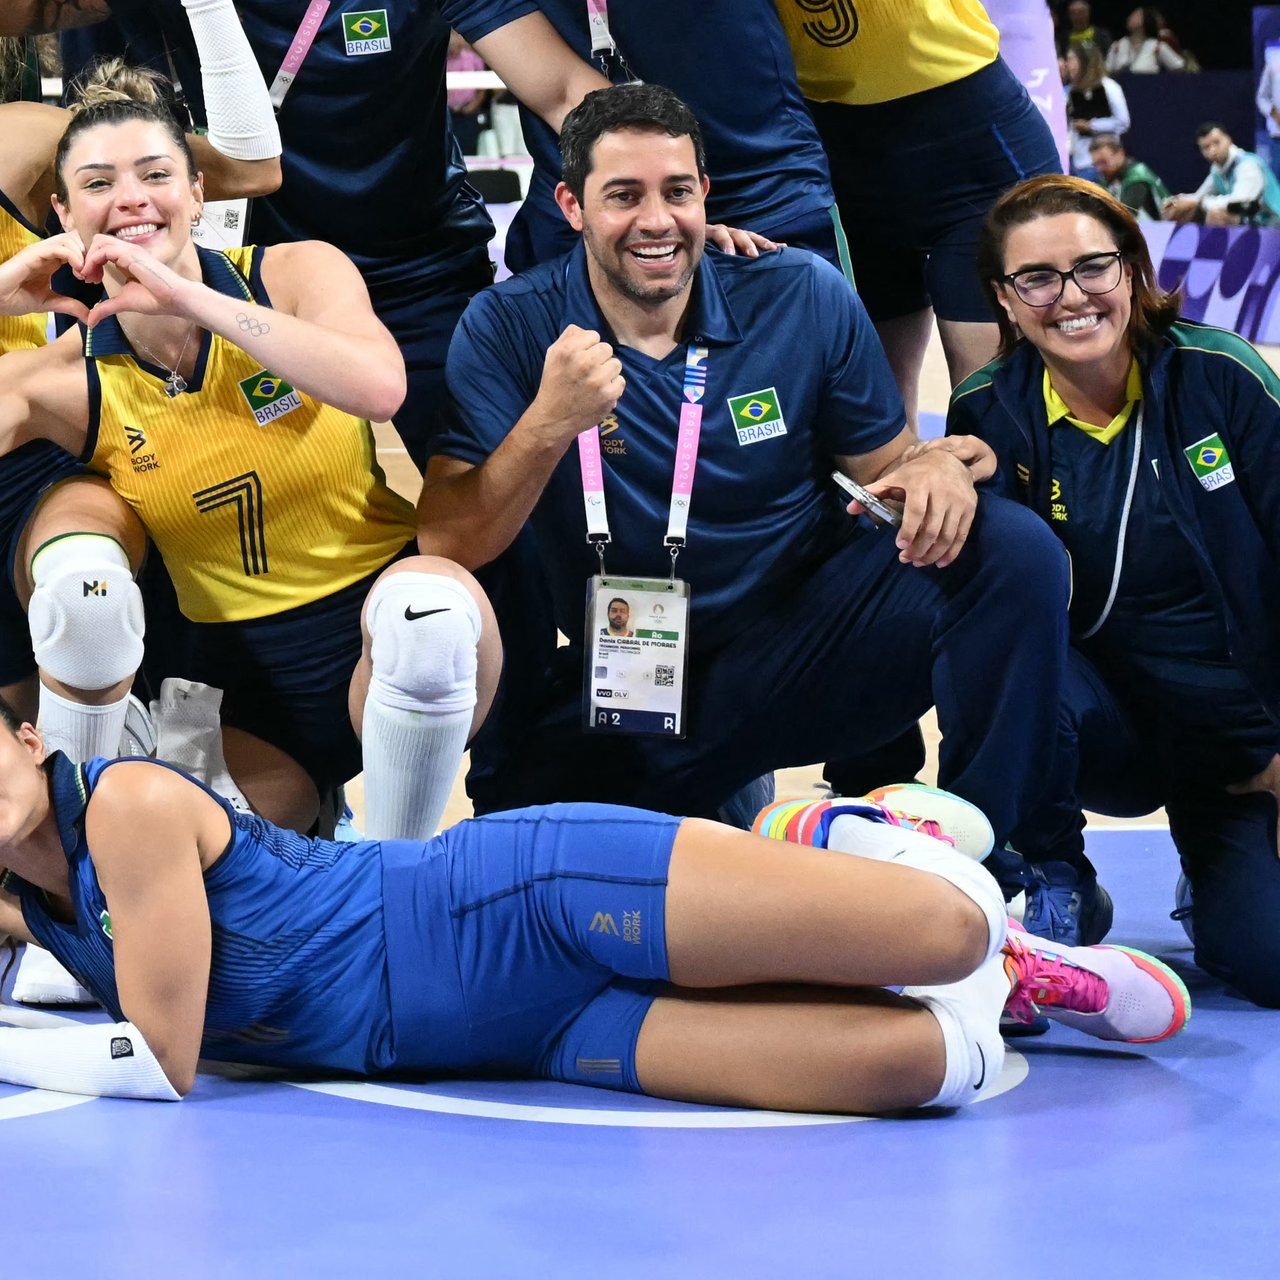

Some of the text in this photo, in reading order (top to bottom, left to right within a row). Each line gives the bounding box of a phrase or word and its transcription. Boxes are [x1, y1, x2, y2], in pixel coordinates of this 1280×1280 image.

[346, 39, 391, 54] BRASIL
[255, 393, 302, 424] BRASIL
[683, 411, 695, 449] PARIS
[737, 421, 784, 443] BRASIL
[602, 439, 624, 448] ODY
[606, 446, 627, 455] ORK
[131, 453, 156, 465] BODY
[133, 461, 160, 473] WORK
[1052, 503, 1066, 512] ODY
[193, 470, 269, 576] 7
[1052, 512, 1068, 521] ORK
[598, 711, 674, 730] A 2 R
[622, 911, 631, 942] BODY
[631, 909, 641, 945] WORK
